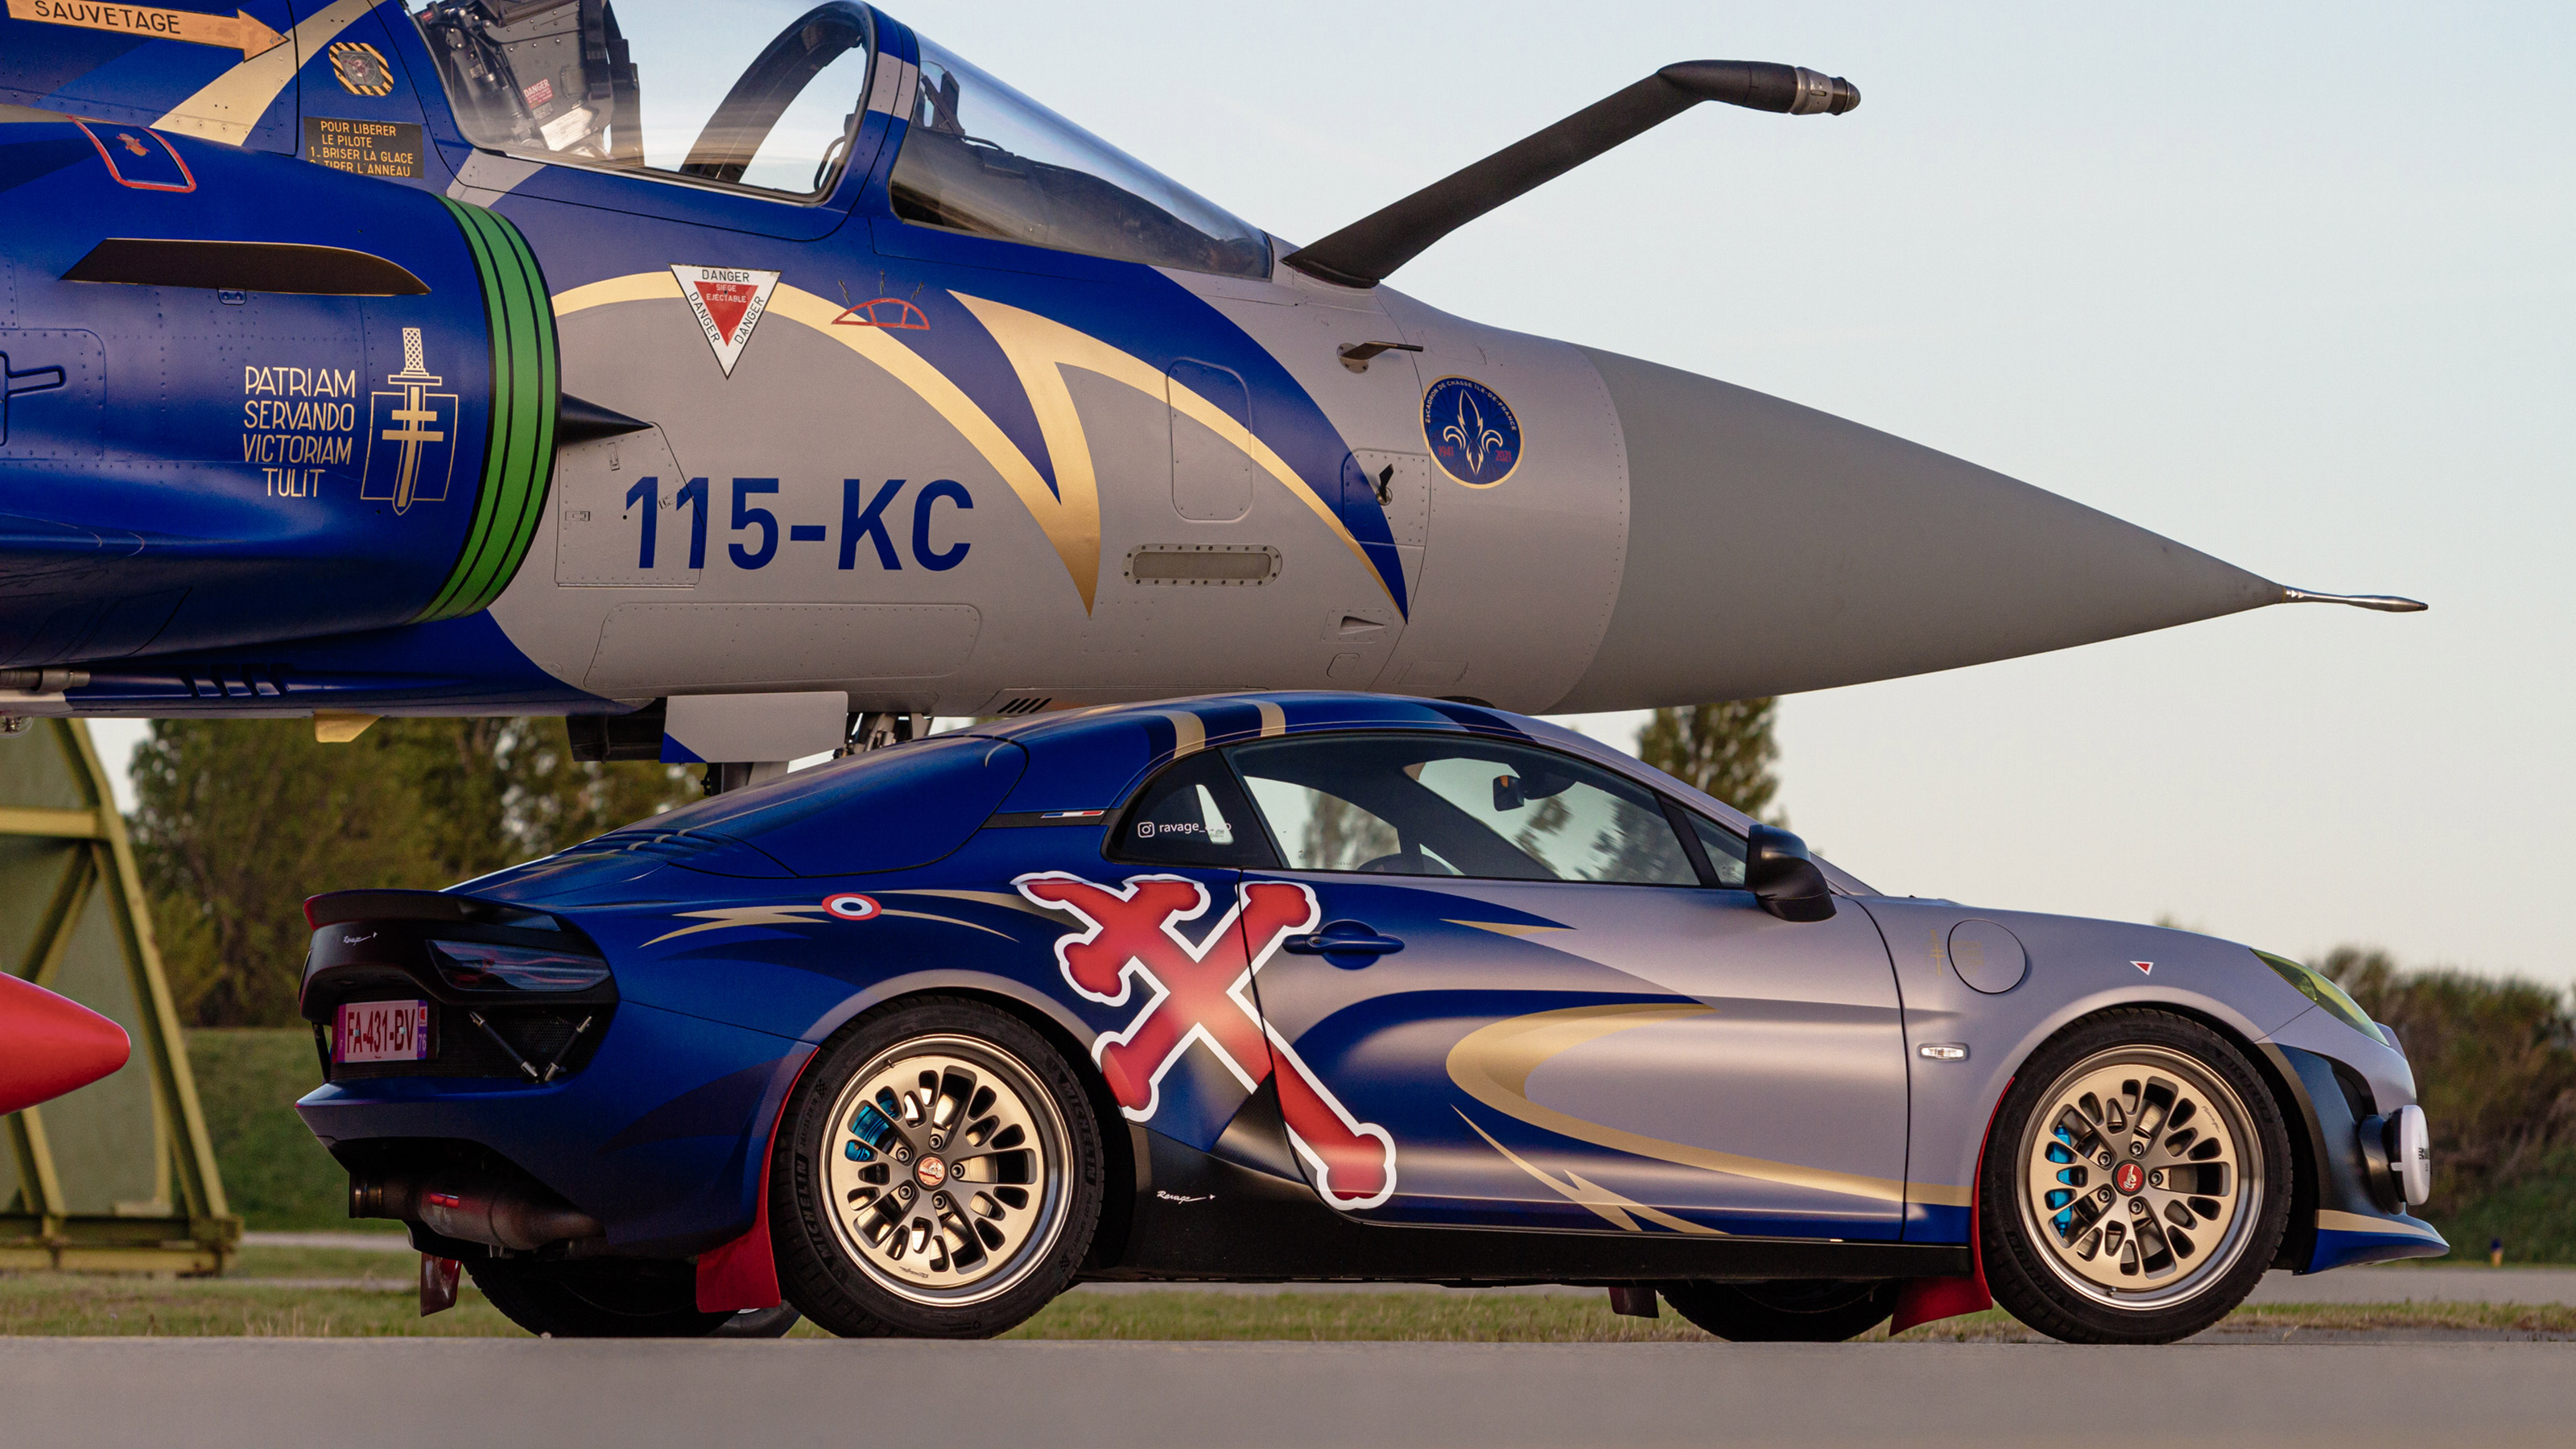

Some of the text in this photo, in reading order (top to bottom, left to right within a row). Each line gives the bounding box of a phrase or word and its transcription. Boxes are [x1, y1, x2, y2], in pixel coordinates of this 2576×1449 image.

[35, 0, 181, 34] SAUVETAGE
[523, 79, 550, 97] DANGER
[320, 121, 396, 136] POUR LIBERER
[322, 134, 373, 147] LE PILOTE
[323, 147, 360, 159] BRISER
[364, 150, 377, 161] LA
[381, 151, 413, 164] GLACE
[702, 269, 749, 283] DANGER
[716, 284, 737, 292] SIEGE
[706, 294, 746, 303] EJECTABLE
[689, 291, 720, 343] DANGER
[734, 295, 764, 345] DANGER
[245, 365, 356, 398] PATRIAM
[244, 400, 355, 431] SERVANDO
[1425, 388, 1439, 423] ESCADRON
[1438, 382, 1447, 390] DE
[1447, 380, 1472, 388] CHASSE
[243, 433, 353, 465] VICTORIAM
[1495, 449, 1512, 462] 2021
[262, 468, 325, 497] TULIT
[625, 476, 974, 572] 115-KC
[347, 1009, 415, 1054] FA-431-BV
[418, 1034, 427, 1051] 76
[796, 1158, 832, 1258] MICHELIN
